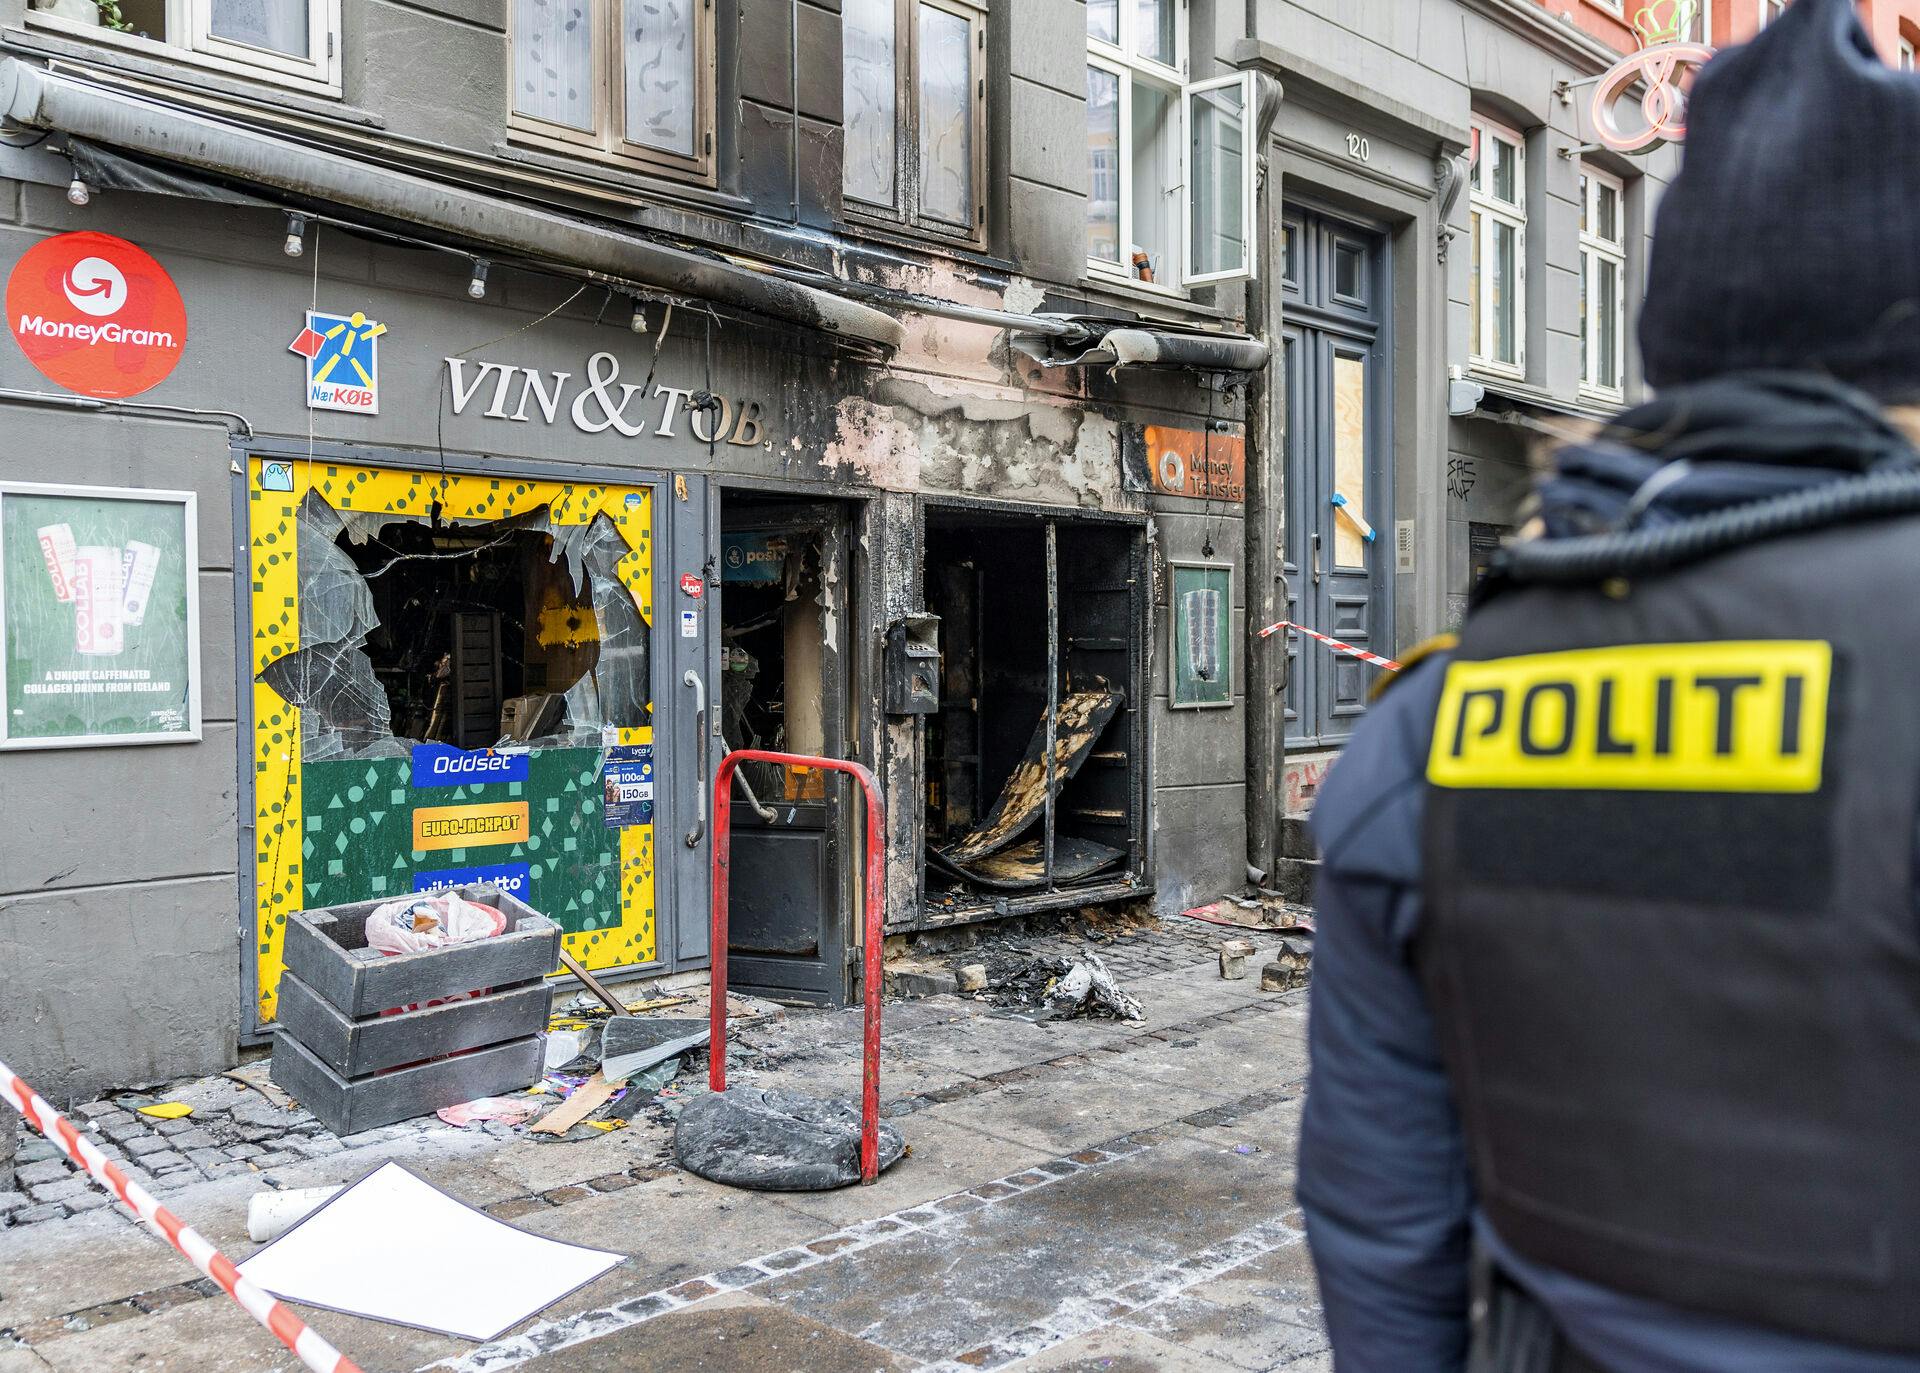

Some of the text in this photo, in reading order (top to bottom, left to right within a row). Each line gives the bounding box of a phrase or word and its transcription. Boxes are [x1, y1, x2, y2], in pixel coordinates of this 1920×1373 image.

[1345, 132, 1369, 161] 120
[19, 314, 173, 347] MoneyGram
[311, 385, 374, 406] NærKØB
[1189, 452, 1233, 476] Money
[1189, 475, 1244, 499] Transfer
[76, 561, 90, 646] COLLAB
[23, 681, 171, 694] COLLAGEN DRINK FROM ICELAND
[45, 670, 151, 681] A UNIQUE CAFFEINATED
[1450, 674, 1806, 759] POLITI
[433, 755, 511, 774] Oddset
[421, 814, 520, 838] EUROJACKPOT
